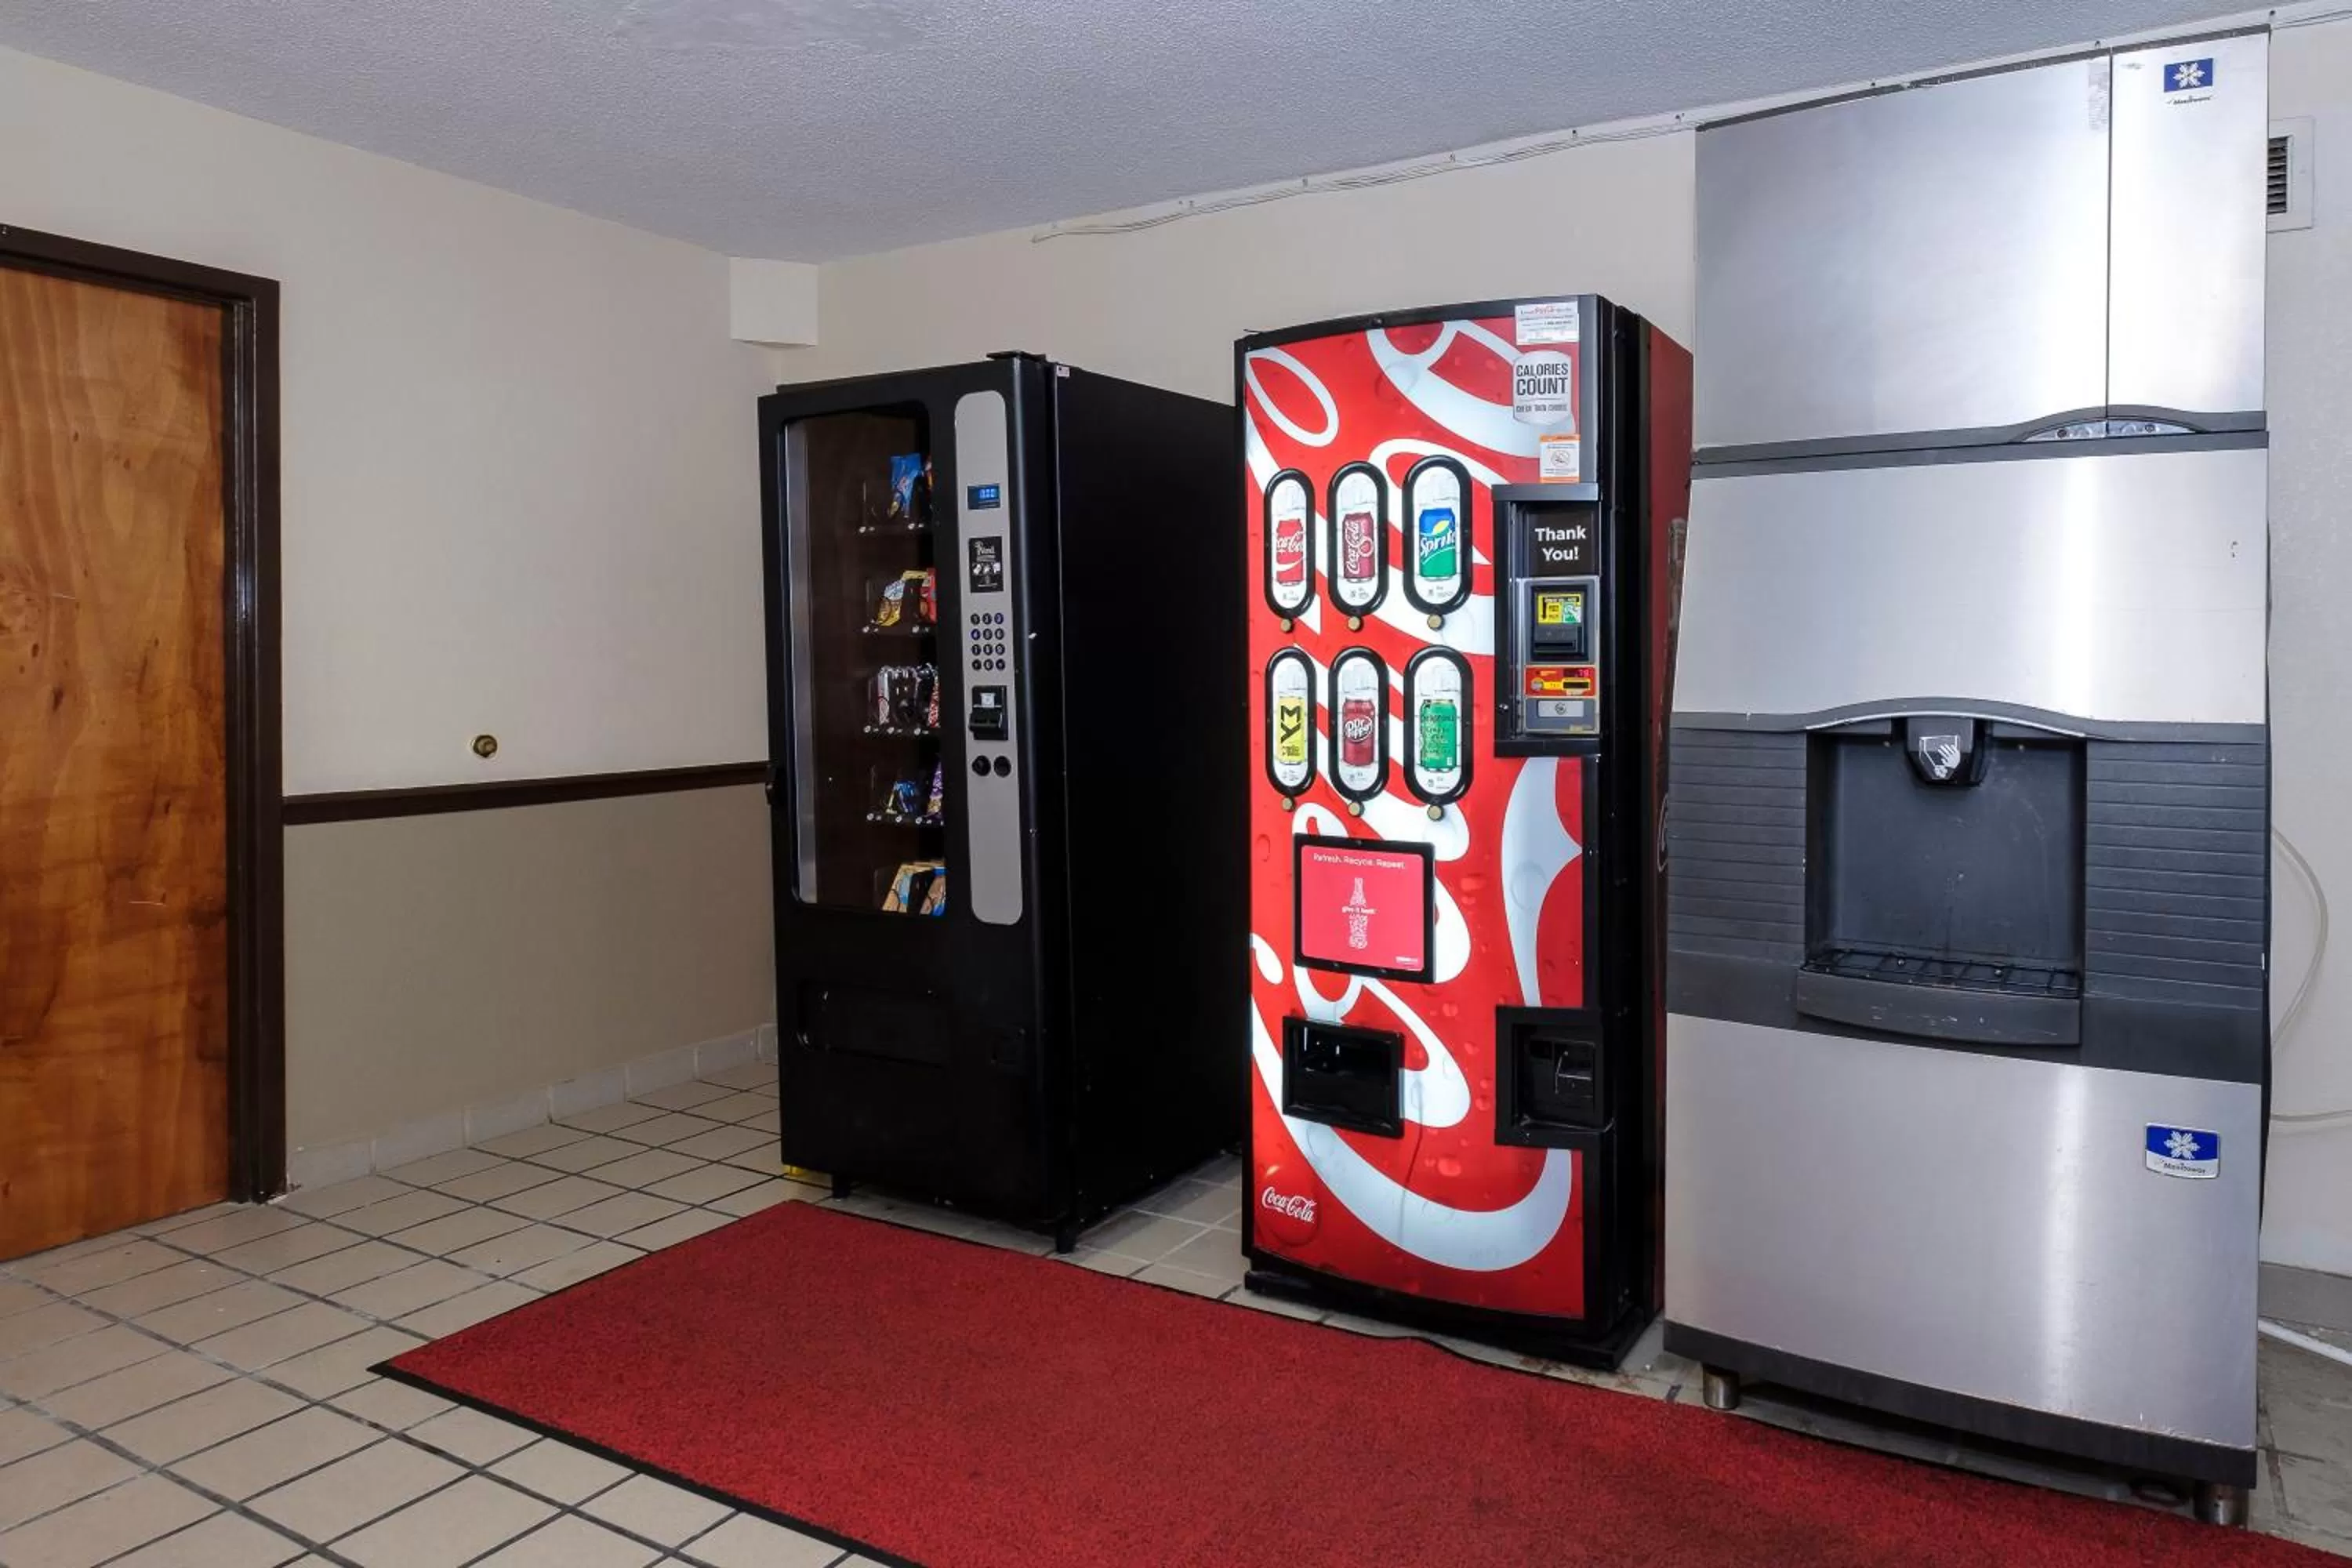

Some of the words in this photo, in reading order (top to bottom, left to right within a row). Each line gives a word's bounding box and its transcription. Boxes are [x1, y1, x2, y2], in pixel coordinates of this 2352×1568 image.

[1516, 363, 1569, 377] CALORIES
[1516, 377, 1569, 396] COUNT
[1534, 524, 1587, 542] Thank
[1541, 546, 1579, 562] You!
[1261, 1185, 1317, 1223] Coca-Cola
